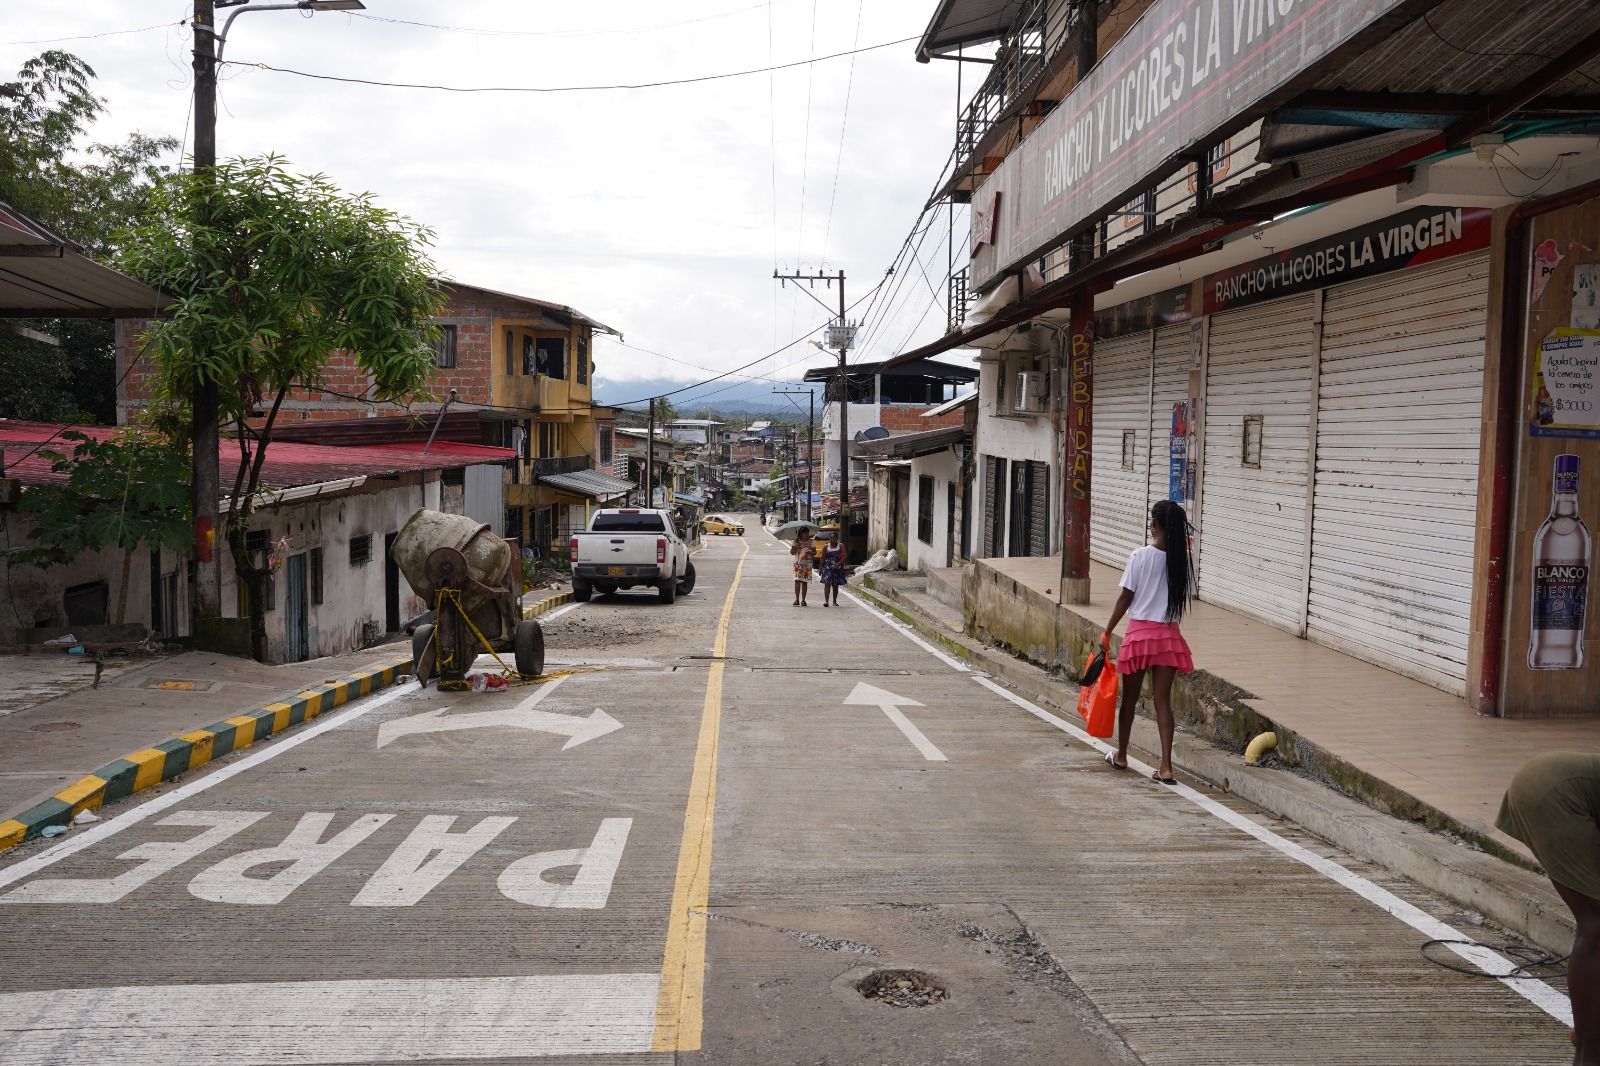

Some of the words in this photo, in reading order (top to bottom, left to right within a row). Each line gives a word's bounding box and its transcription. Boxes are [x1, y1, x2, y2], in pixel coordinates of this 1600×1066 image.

[1044, 110, 1094, 205] RANCHO
[1096, 96, 1107, 162] Y
[1110, 21, 1187, 154] LICORES
[1191, 0, 1221, 88] LA
[1215, 268, 1266, 304] RANCHO
[1269, 262, 1277, 290] Y
[1281, 244, 1345, 286] LICORES
[1350, 236, 1375, 269] LA
[1379, 207, 1462, 259] VIRGEN
[1072, 333, 1090, 499] BEBIDAS
[1548, 369, 1555, 377] la
[1583, 370, 1592, 379] de
[1537, 566, 1585, 579] BLANCO
[0, 809, 633, 909] PARE
